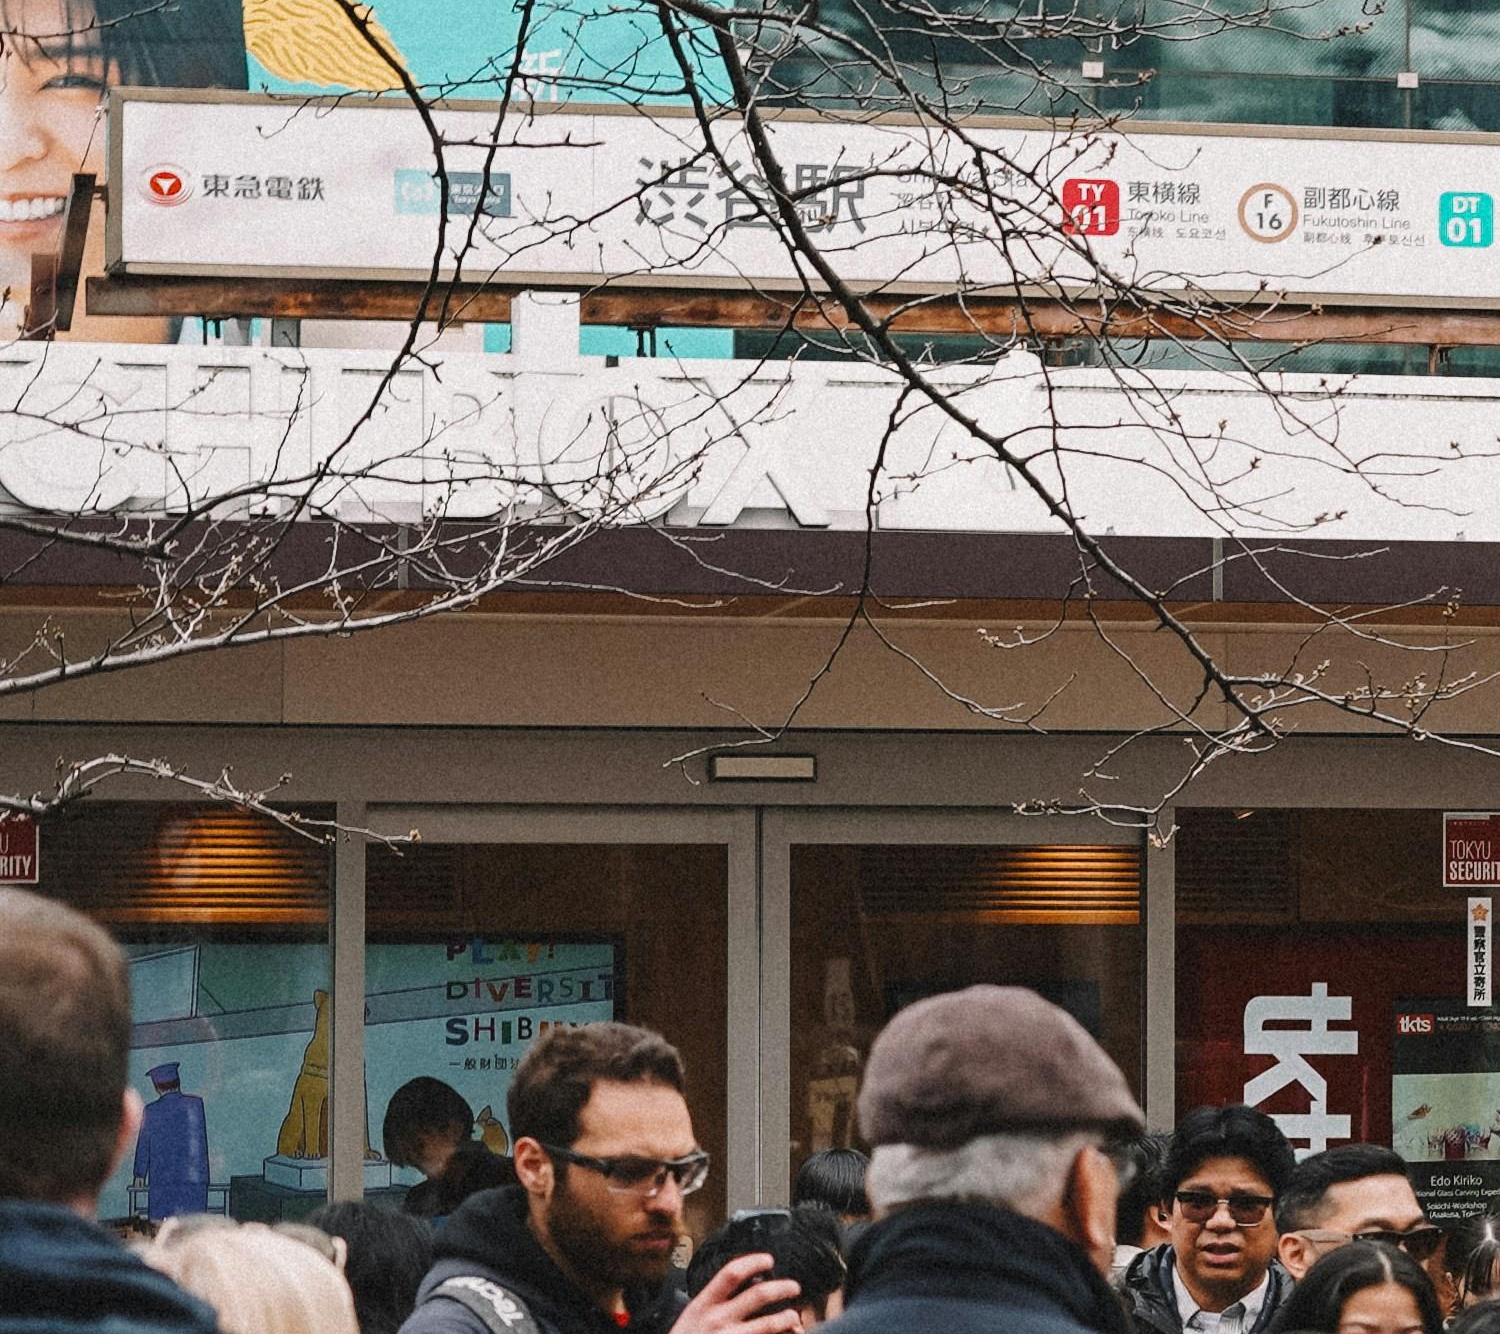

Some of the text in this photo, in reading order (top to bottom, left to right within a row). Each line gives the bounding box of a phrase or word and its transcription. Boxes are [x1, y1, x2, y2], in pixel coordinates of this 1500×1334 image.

[201, 173, 326, 203] 東急電鉄
[1077, 182, 1106, 201] TY
[1127, 180, 1200, 205] 東横線
[1263, 194, 1274, 209] F
[1303, 186, 1400, 212] 副都心線
[1451, 195, 1481, 214] DT
[1070, 202, 1106, 233] 01
[1181, 210, 1209, 223] Line
[1256, 212, 1283, 232] 16
[1303, 213, 1411, 230] Fukutoshin Line
[1446, 217, 1483, 244] 01
[1449, 839, 1491, 860] TOKYU
[446, 938, 556, 965] PLAY!
[1472, 925, 1487, 1002] 警察官立寄所
[1399, 1014, 1432, 1034] tkts
[1430, 1174, 1483, 1187] Edo Kiriko
